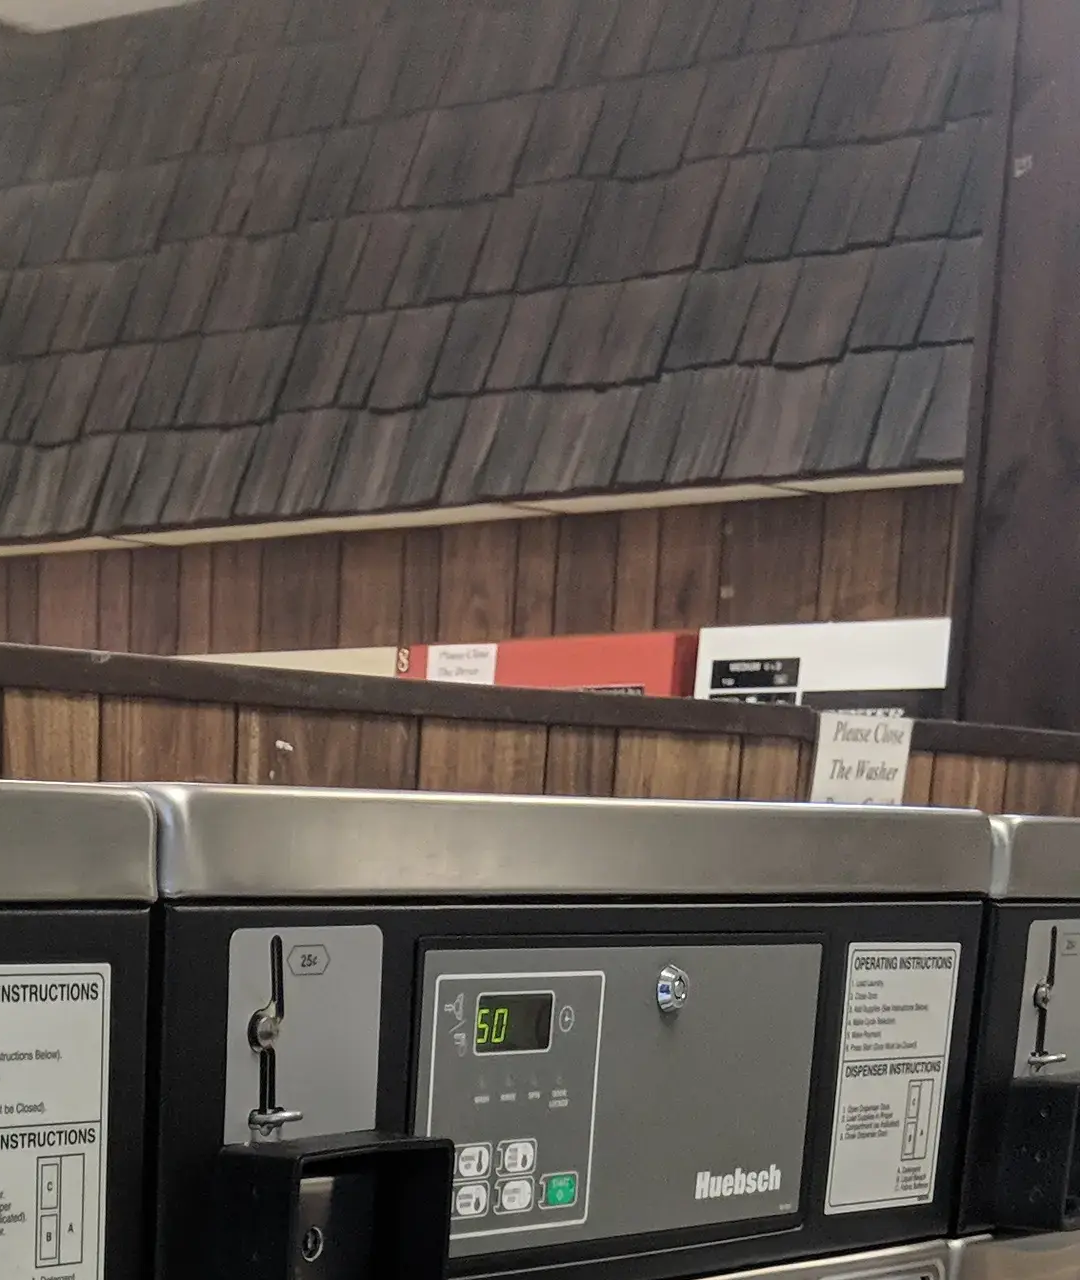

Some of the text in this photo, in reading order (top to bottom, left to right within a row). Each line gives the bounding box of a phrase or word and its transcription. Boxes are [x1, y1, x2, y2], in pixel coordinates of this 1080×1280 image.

[833, 720, 904, 744] Please Close
[829, 757, 899, 781] The Washer
[854, 956, 953, 970] OPERATING INSTRUCTIONS
[845, 1061, 941, 1078] DISPENSER INSTRUCTIONS
[4, 1103, 14, 1114] be
[47, 1181, 53, 1192] C
[695, 1163, 782, 1200] Huebsch
[67, 1223, 74, 1233] A
[46, 1231, 52, 1242] B
